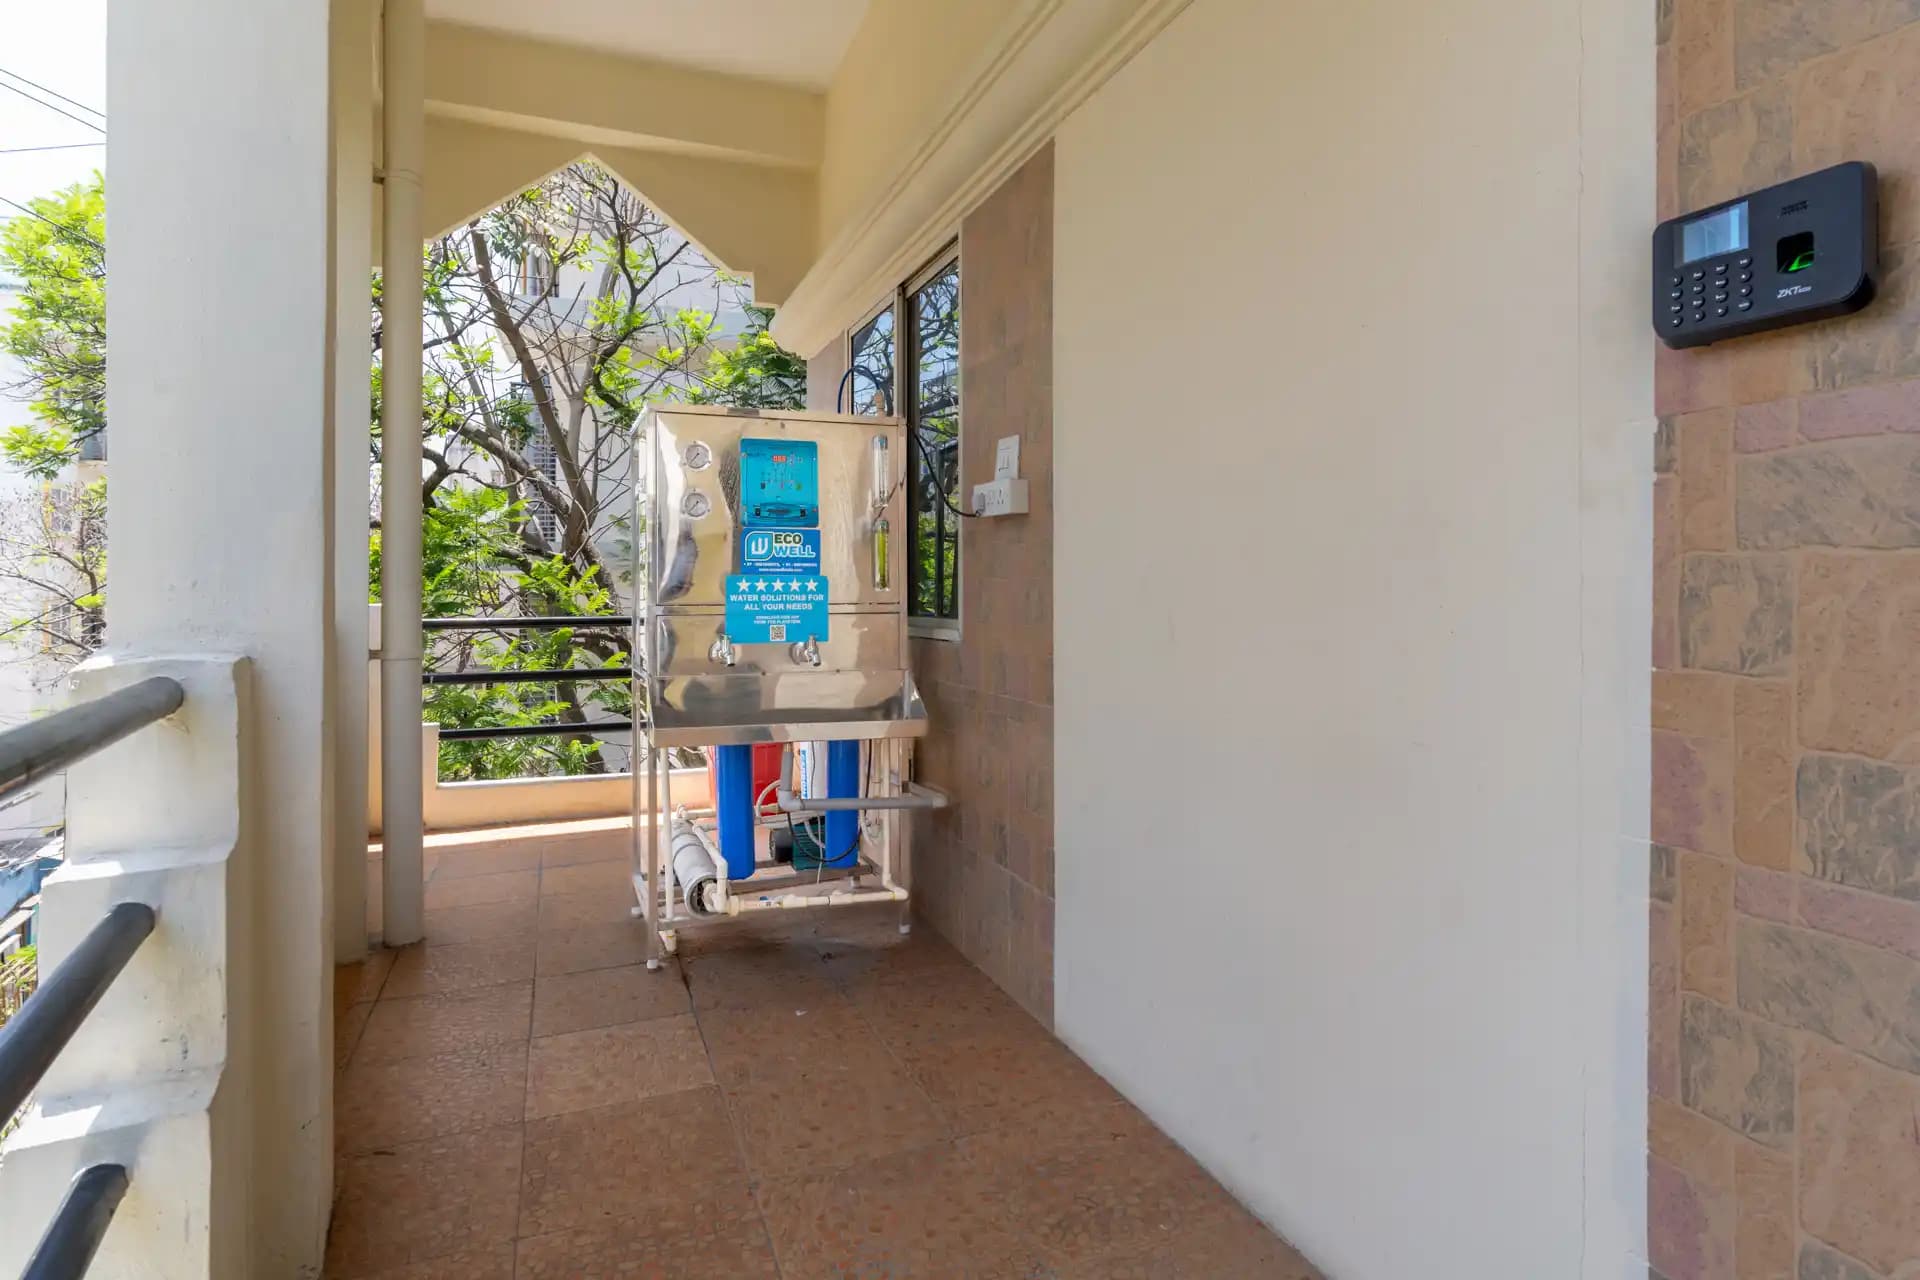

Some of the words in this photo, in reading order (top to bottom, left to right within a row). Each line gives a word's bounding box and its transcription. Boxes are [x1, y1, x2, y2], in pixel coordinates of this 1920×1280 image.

[774, 533, 802, 545] ECO
[773, 545, 816, 558] WELL
[730, 594, 759, 602] WATER
[761, 594, 806, 602] SOLUTIONS
[744, 603, 760, 611] ALL
